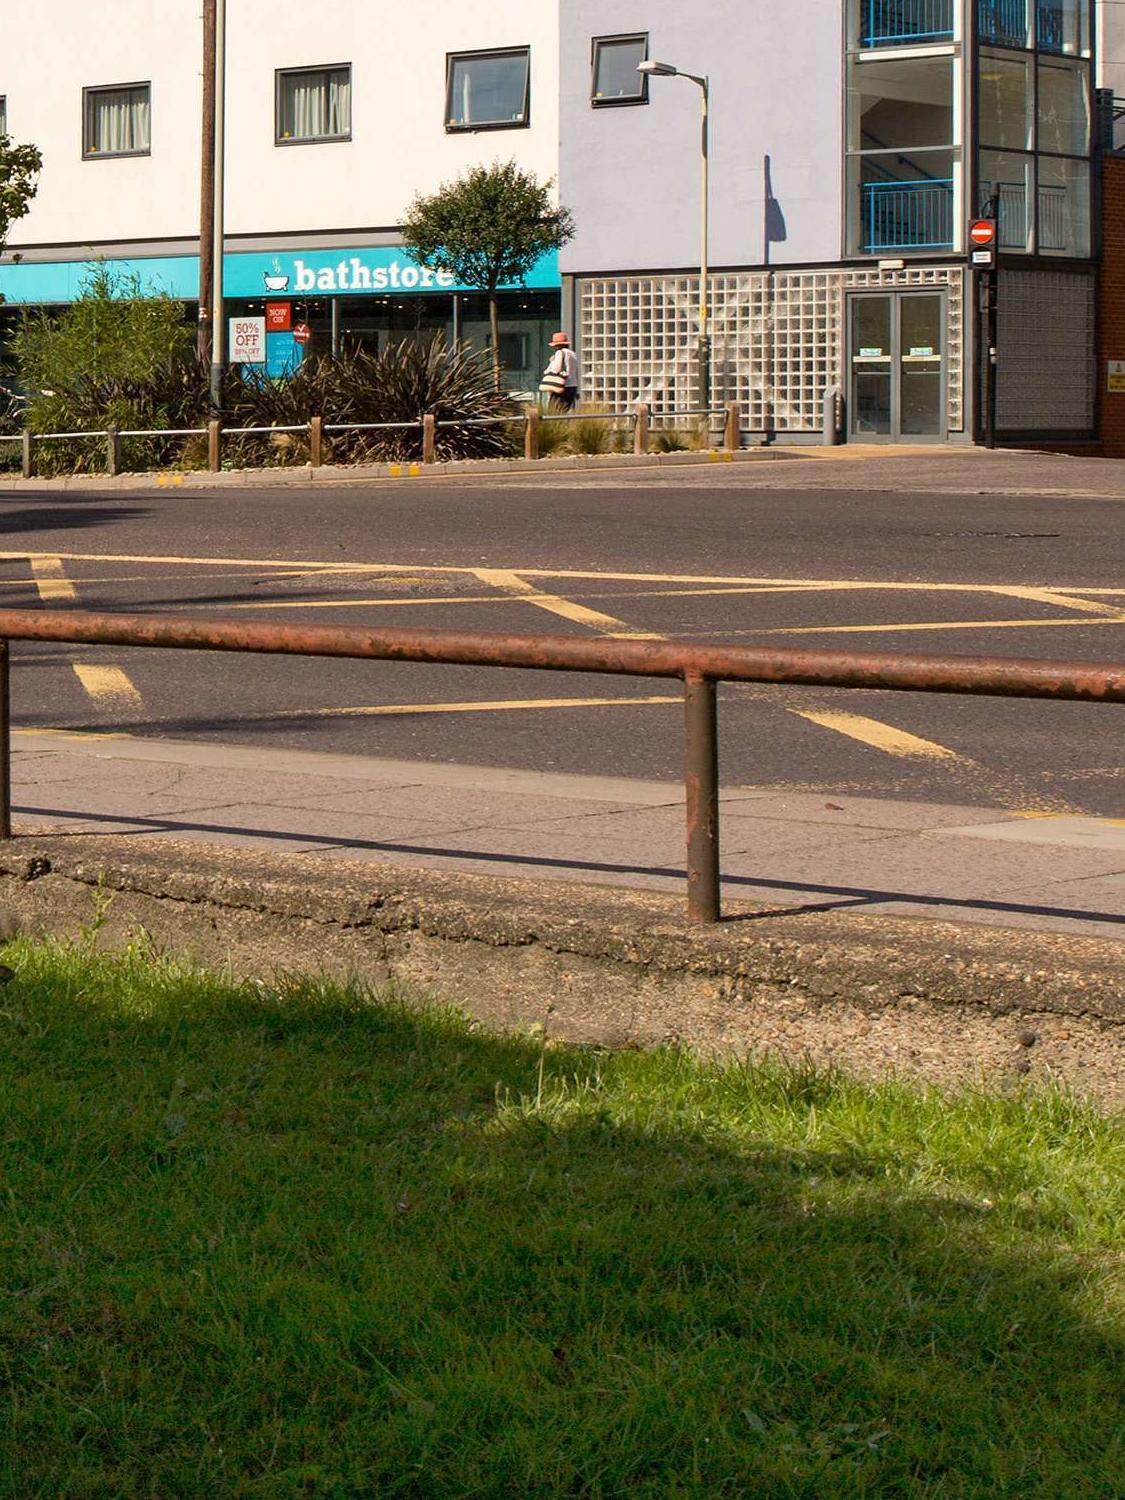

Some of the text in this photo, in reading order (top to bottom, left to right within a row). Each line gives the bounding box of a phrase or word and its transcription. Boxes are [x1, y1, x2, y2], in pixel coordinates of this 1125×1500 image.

[269, 308, 287, 317] NOW
[272, 316, 284, 324] ON
[236, 323, 259, 334] 50%
[236, 335, 259, 347] OFF
